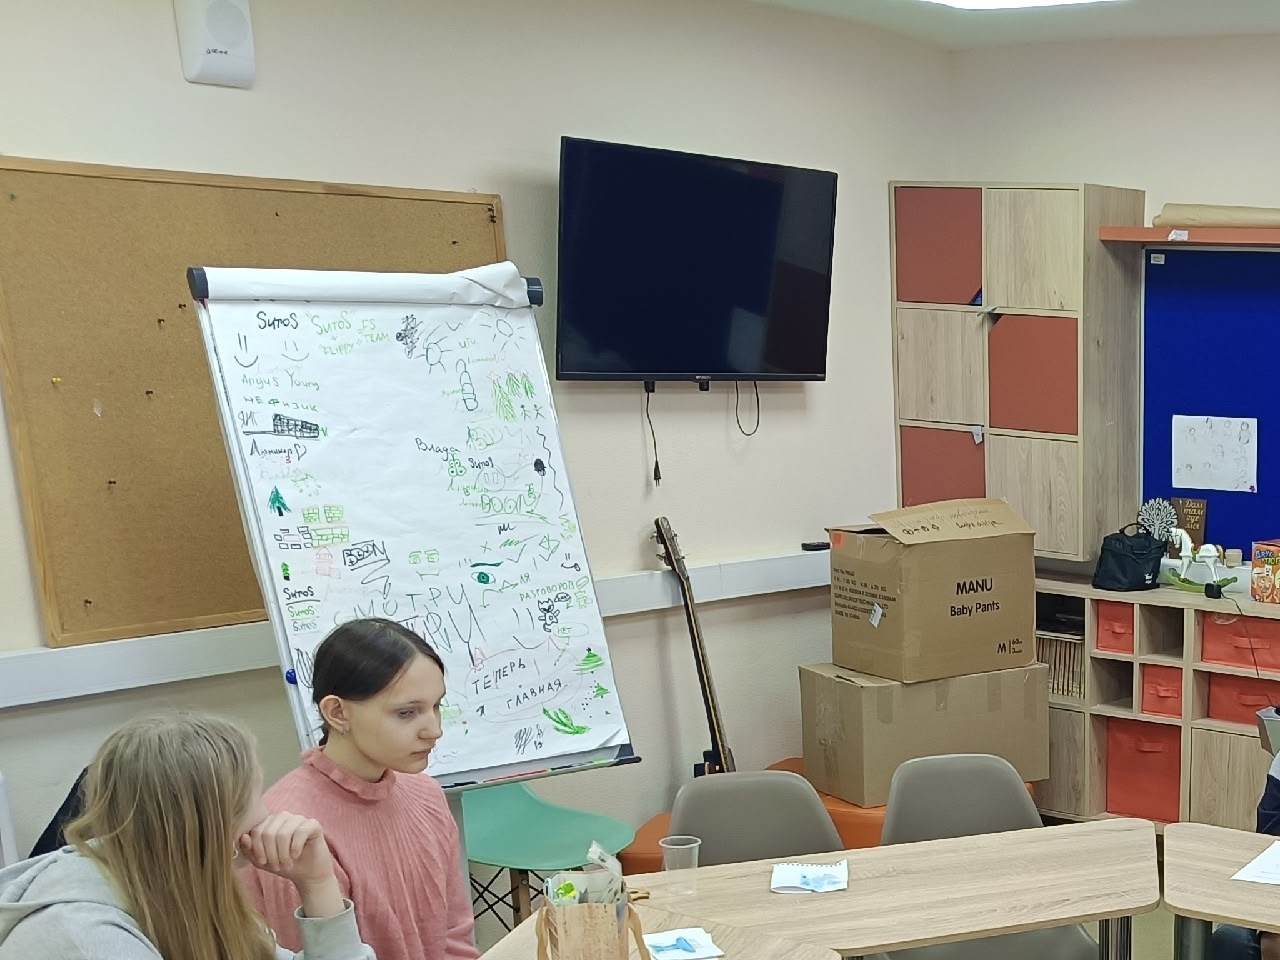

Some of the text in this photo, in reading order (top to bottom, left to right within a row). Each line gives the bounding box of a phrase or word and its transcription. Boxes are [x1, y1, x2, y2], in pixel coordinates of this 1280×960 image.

[955, 577, 993, 596] MANU
[950, 600, 1000, 619] Baby Pants
[472, 658, 526, 695] ТЕПЕРЬ
[506, 678, 563, 709] ГЛАВНАЯ
